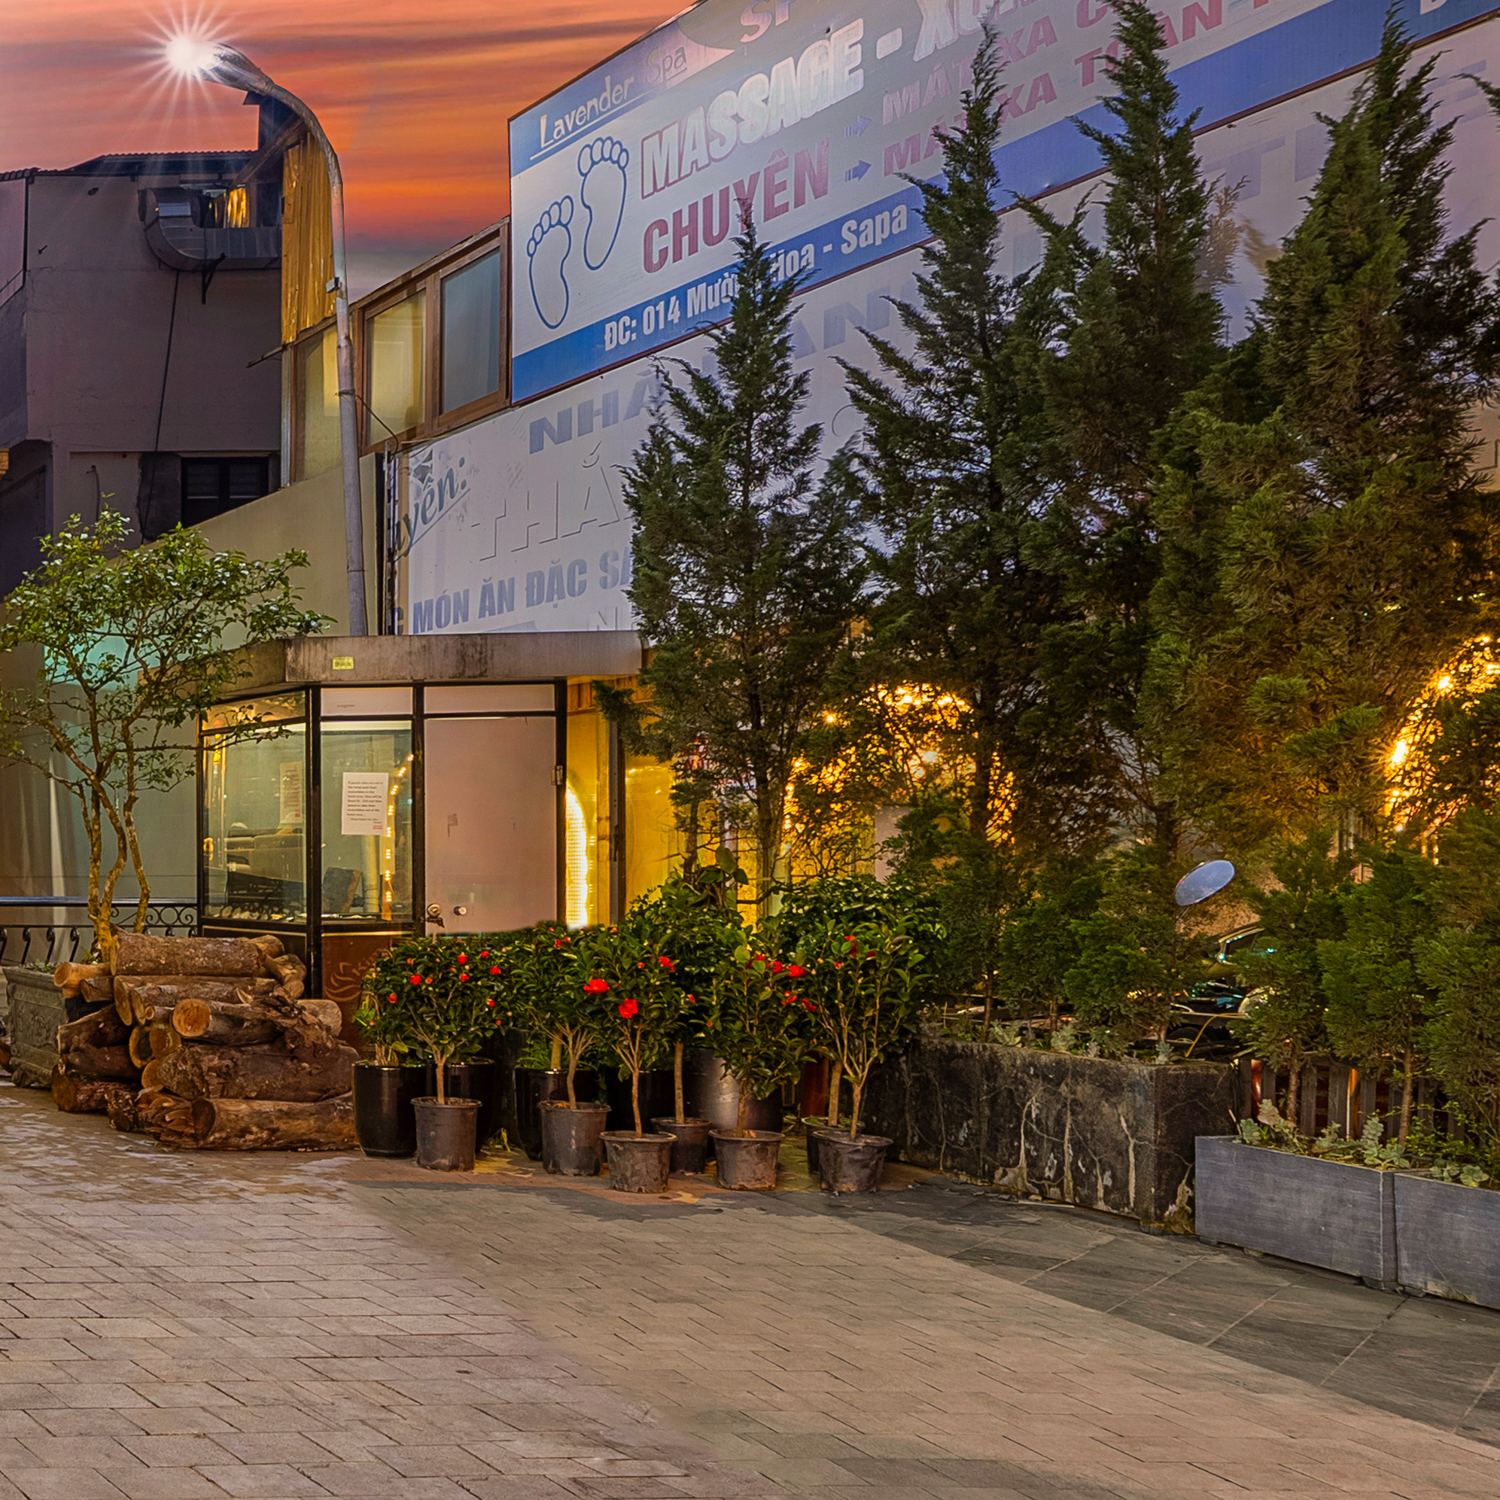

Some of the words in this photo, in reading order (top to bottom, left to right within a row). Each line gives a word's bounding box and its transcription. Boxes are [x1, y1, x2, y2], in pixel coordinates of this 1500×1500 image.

[996, 15, 1059, 64] XA
[540, 75, 635, 149] Lavender
[645, 45, 687, 87] Spa
[640, 18, 865, 200] MASSAGE
[998, 72, 1059, 127] XA
[642, 139, 830, 274] CHUYÊN
[603, 314, 638, 352] ĐC:
[642, 295, 681, 336] 014
[839, 203, 908, 255] Sapa
[412, 587, 470, 636] MÓN
[477, 576, 516, 620] ĂN
[524, 557, 588, 610] ĐẶC
